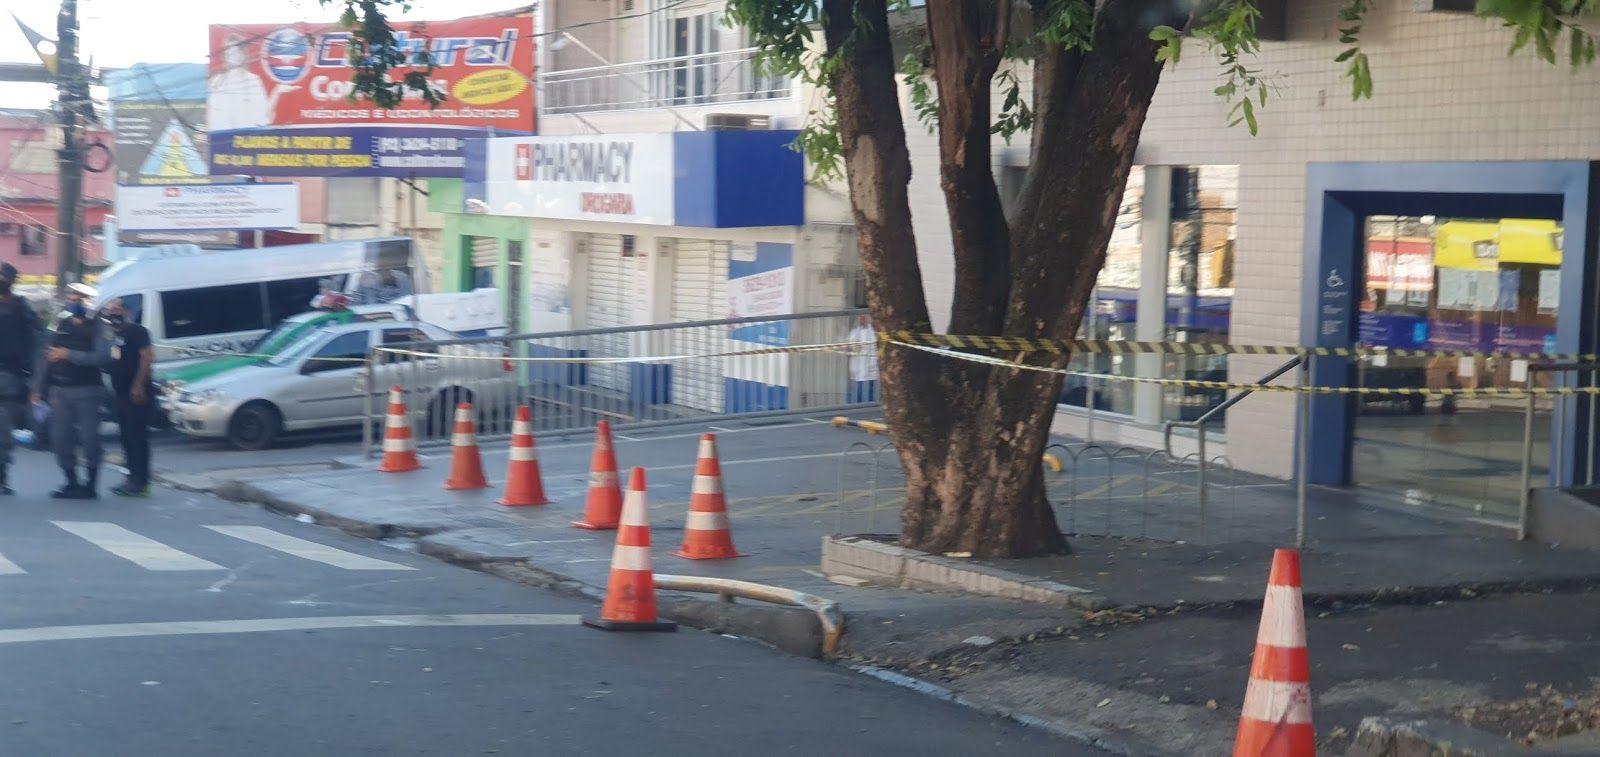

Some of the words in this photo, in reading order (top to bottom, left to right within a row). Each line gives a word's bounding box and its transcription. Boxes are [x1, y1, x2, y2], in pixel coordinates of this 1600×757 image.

[300, 106, 370, 119] MÉDICOS
[372, 109, 385, 118] E
[534, 141, 633, 183] PHARMACY
